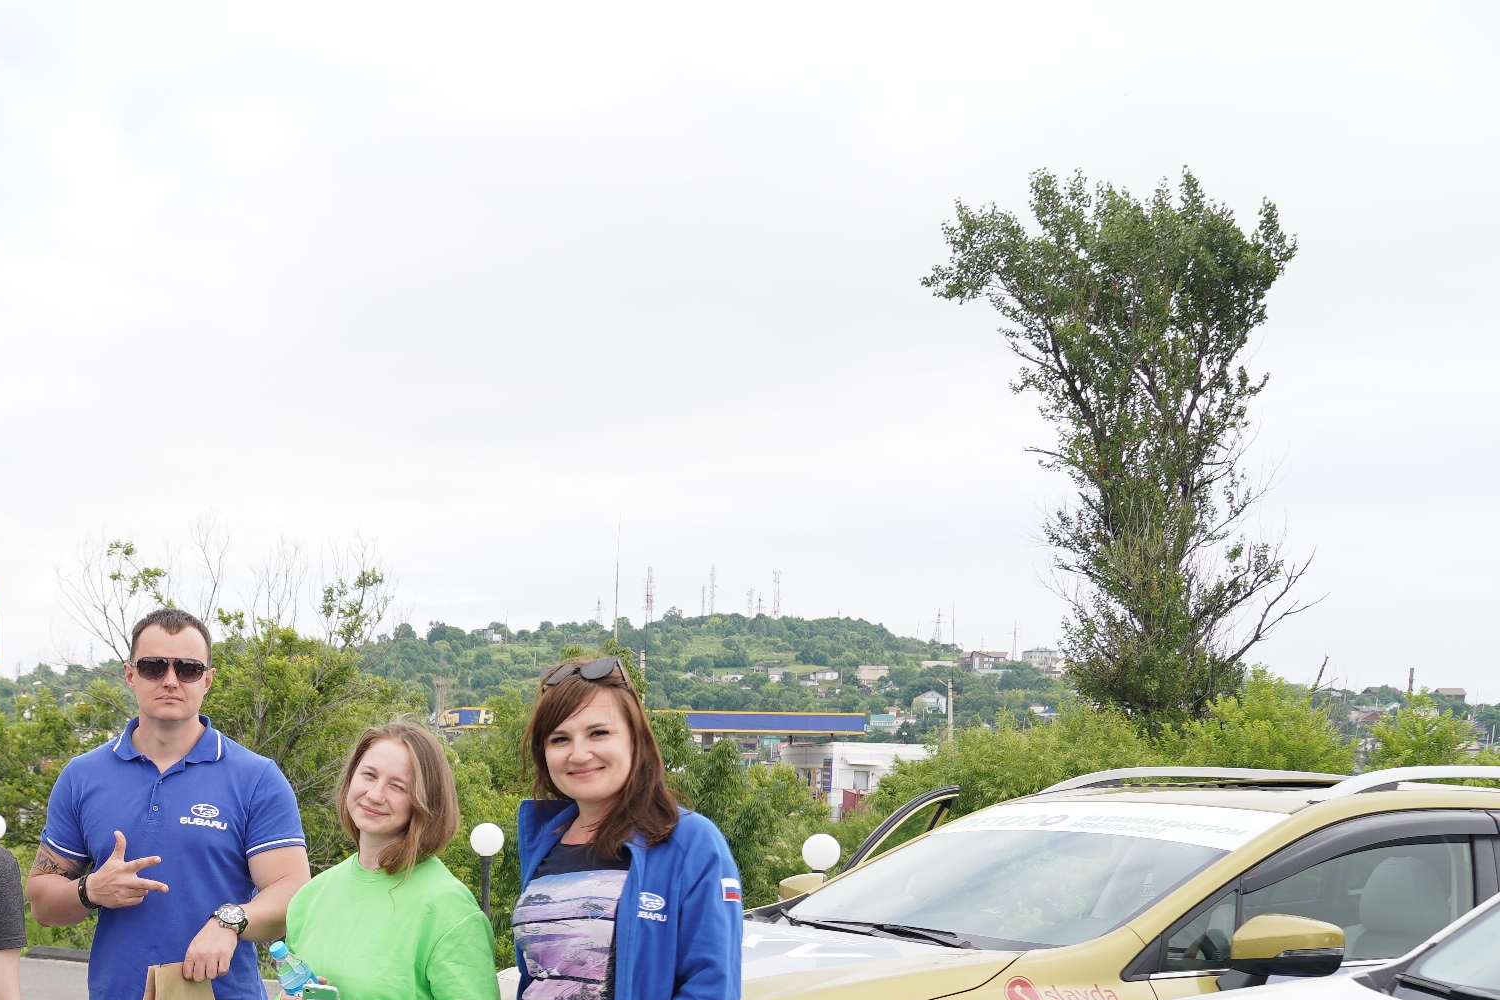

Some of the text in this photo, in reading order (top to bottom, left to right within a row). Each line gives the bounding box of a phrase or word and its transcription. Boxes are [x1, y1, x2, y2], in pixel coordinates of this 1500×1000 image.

[179, 816, 228, 830] SUBARU
[1161, 820, 1248, 837] БЫСТРОМ
[637, 910, 668, 922] BARU
